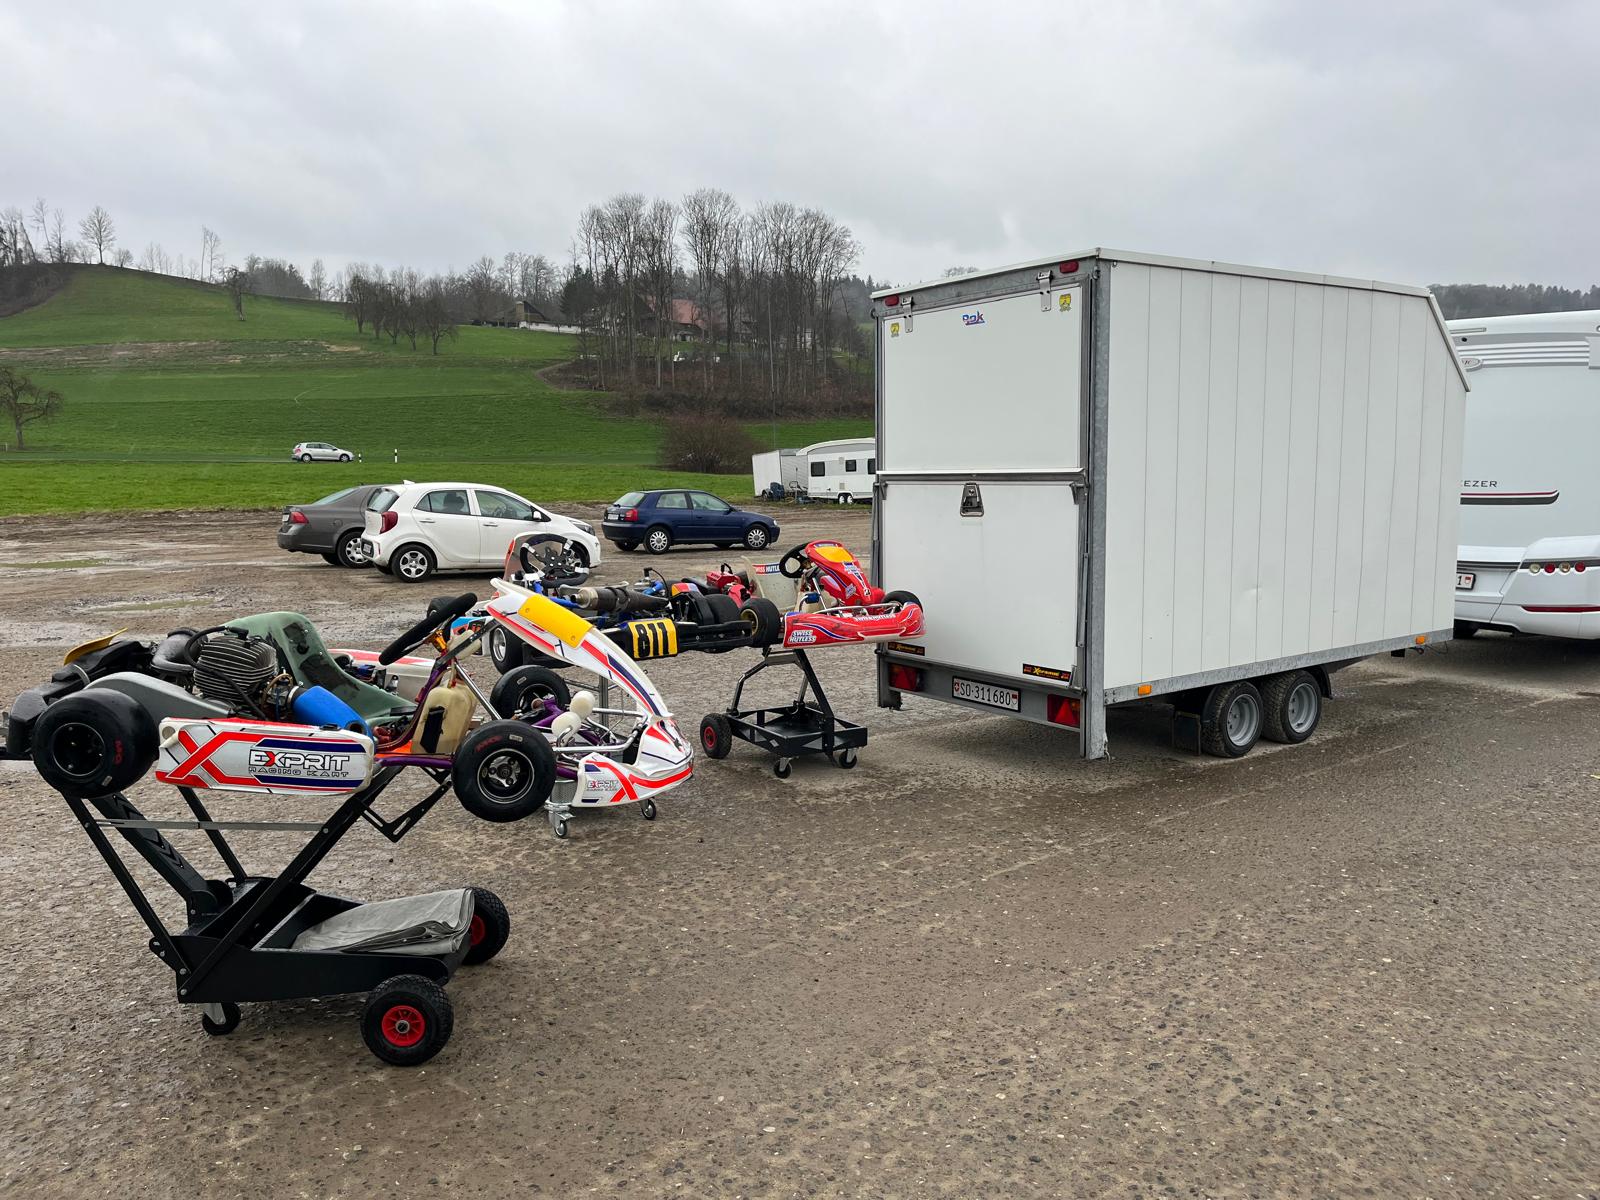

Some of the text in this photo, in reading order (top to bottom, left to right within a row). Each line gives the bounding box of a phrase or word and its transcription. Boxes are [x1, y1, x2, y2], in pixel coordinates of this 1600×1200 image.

[1461, 480, 1498, 488] EZER
[635, 621, 669, 657] 811
[249, 749, 350, 771] EXPRIT
[248, 766, 349, 778] RACING KART
